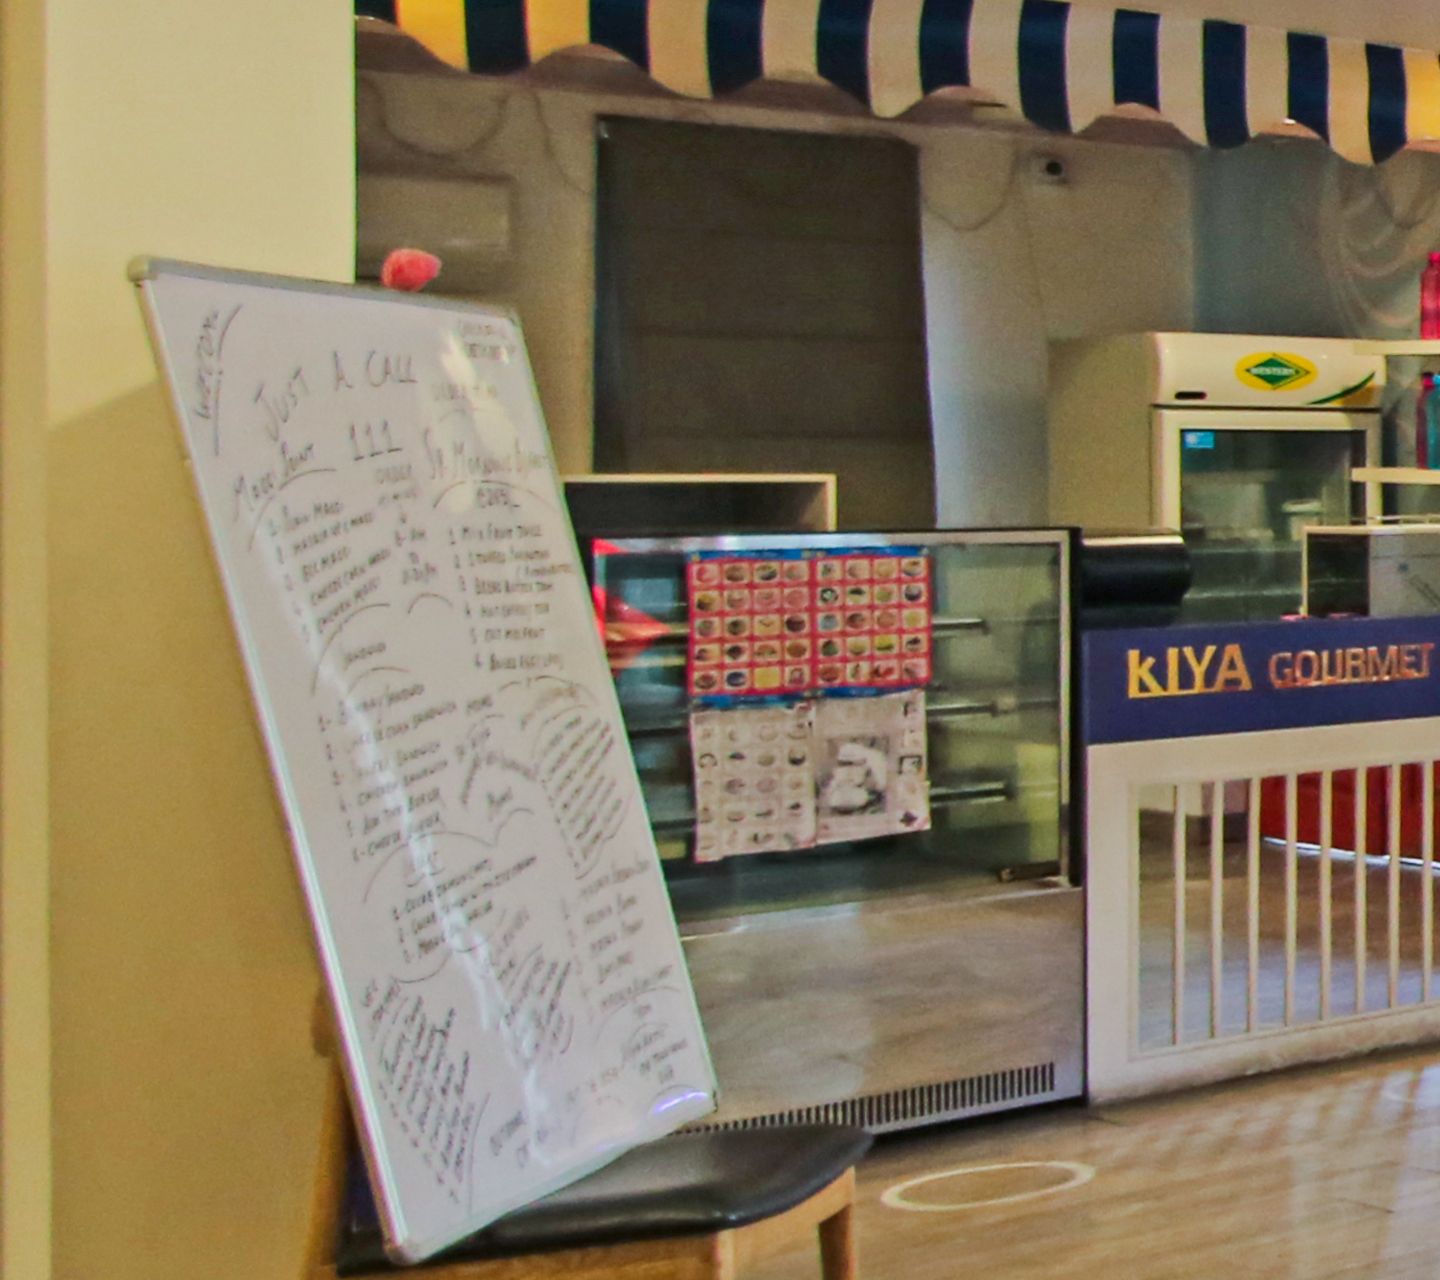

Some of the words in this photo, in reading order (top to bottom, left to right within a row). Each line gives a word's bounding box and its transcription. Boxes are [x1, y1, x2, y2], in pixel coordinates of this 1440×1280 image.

[253, 366, 309, 443] JUST
[332, 349, 354, 393] A
[1268, 642, 1436, 690] GOURMET
